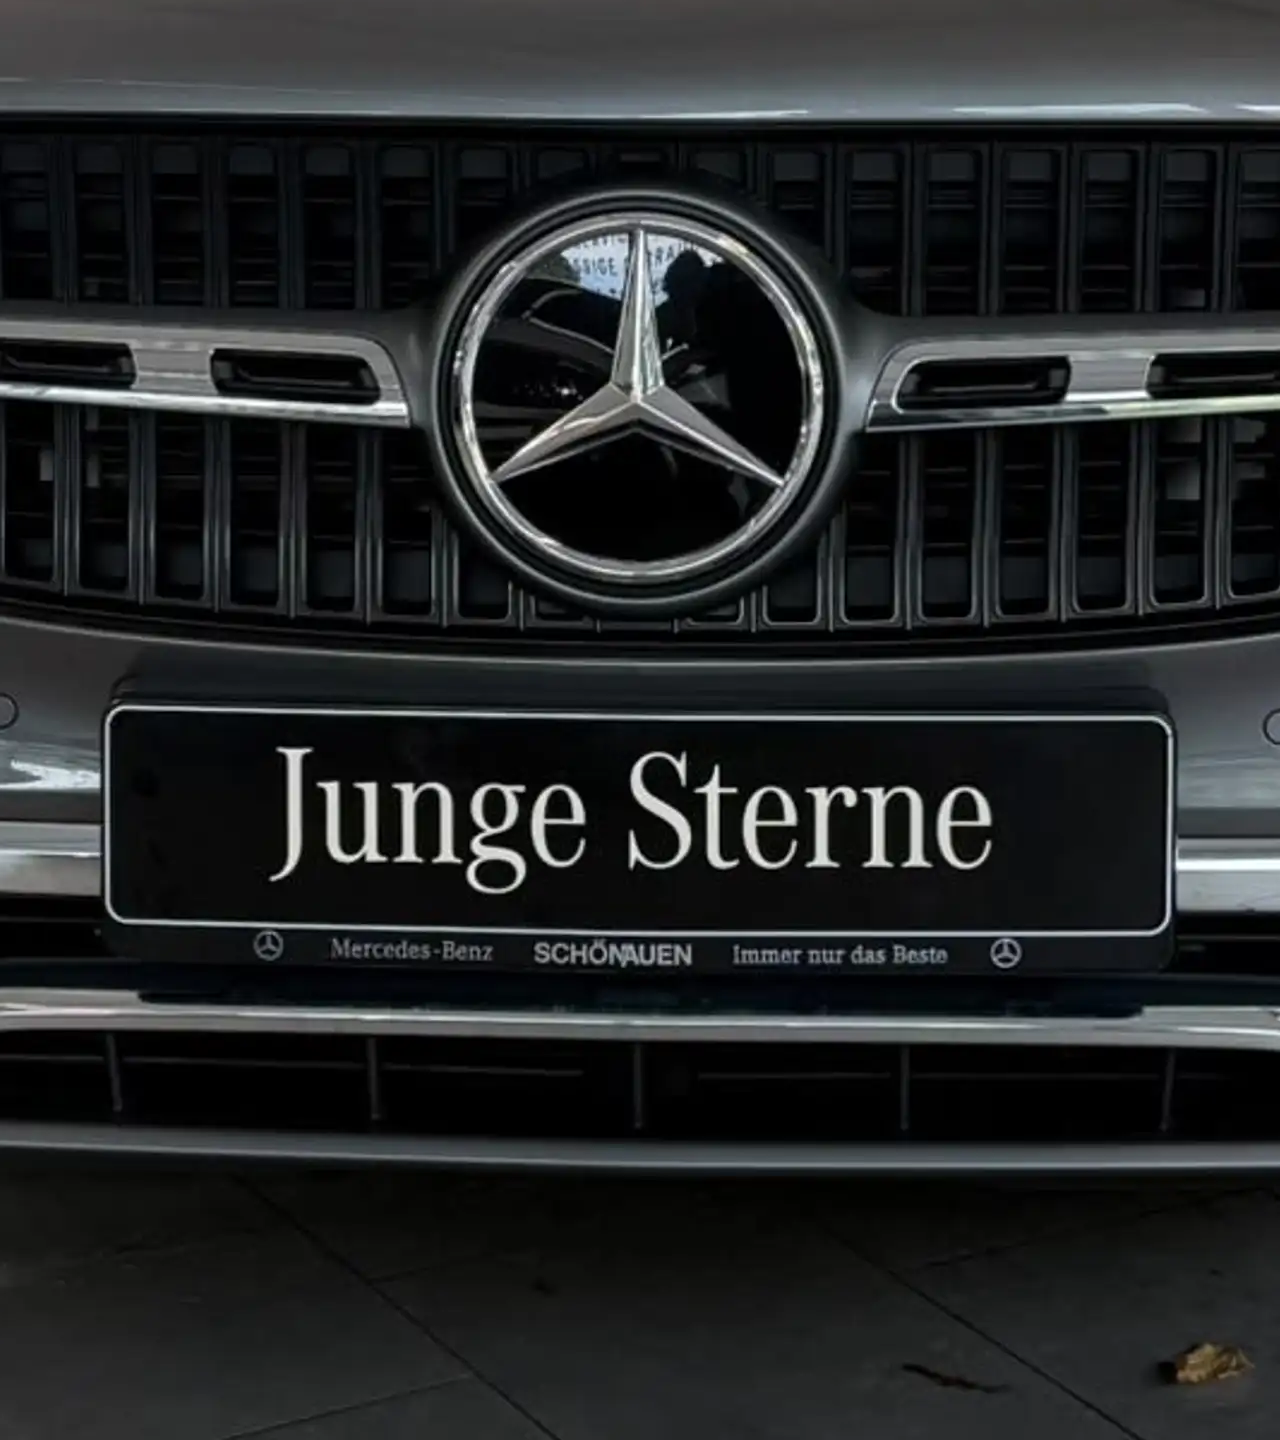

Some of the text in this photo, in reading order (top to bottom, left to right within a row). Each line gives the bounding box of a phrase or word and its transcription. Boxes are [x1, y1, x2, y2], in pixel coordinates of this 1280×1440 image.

[269, 746, 993, 895] Junge Sterne
[331, 937, 494, 961] Mercedes-Benz
[732, 944, 802, 966] Immer
[807, 946, 846, 966] nur
[850, 944, 886, 966] das
[892, 944, 950, 966] Beste
